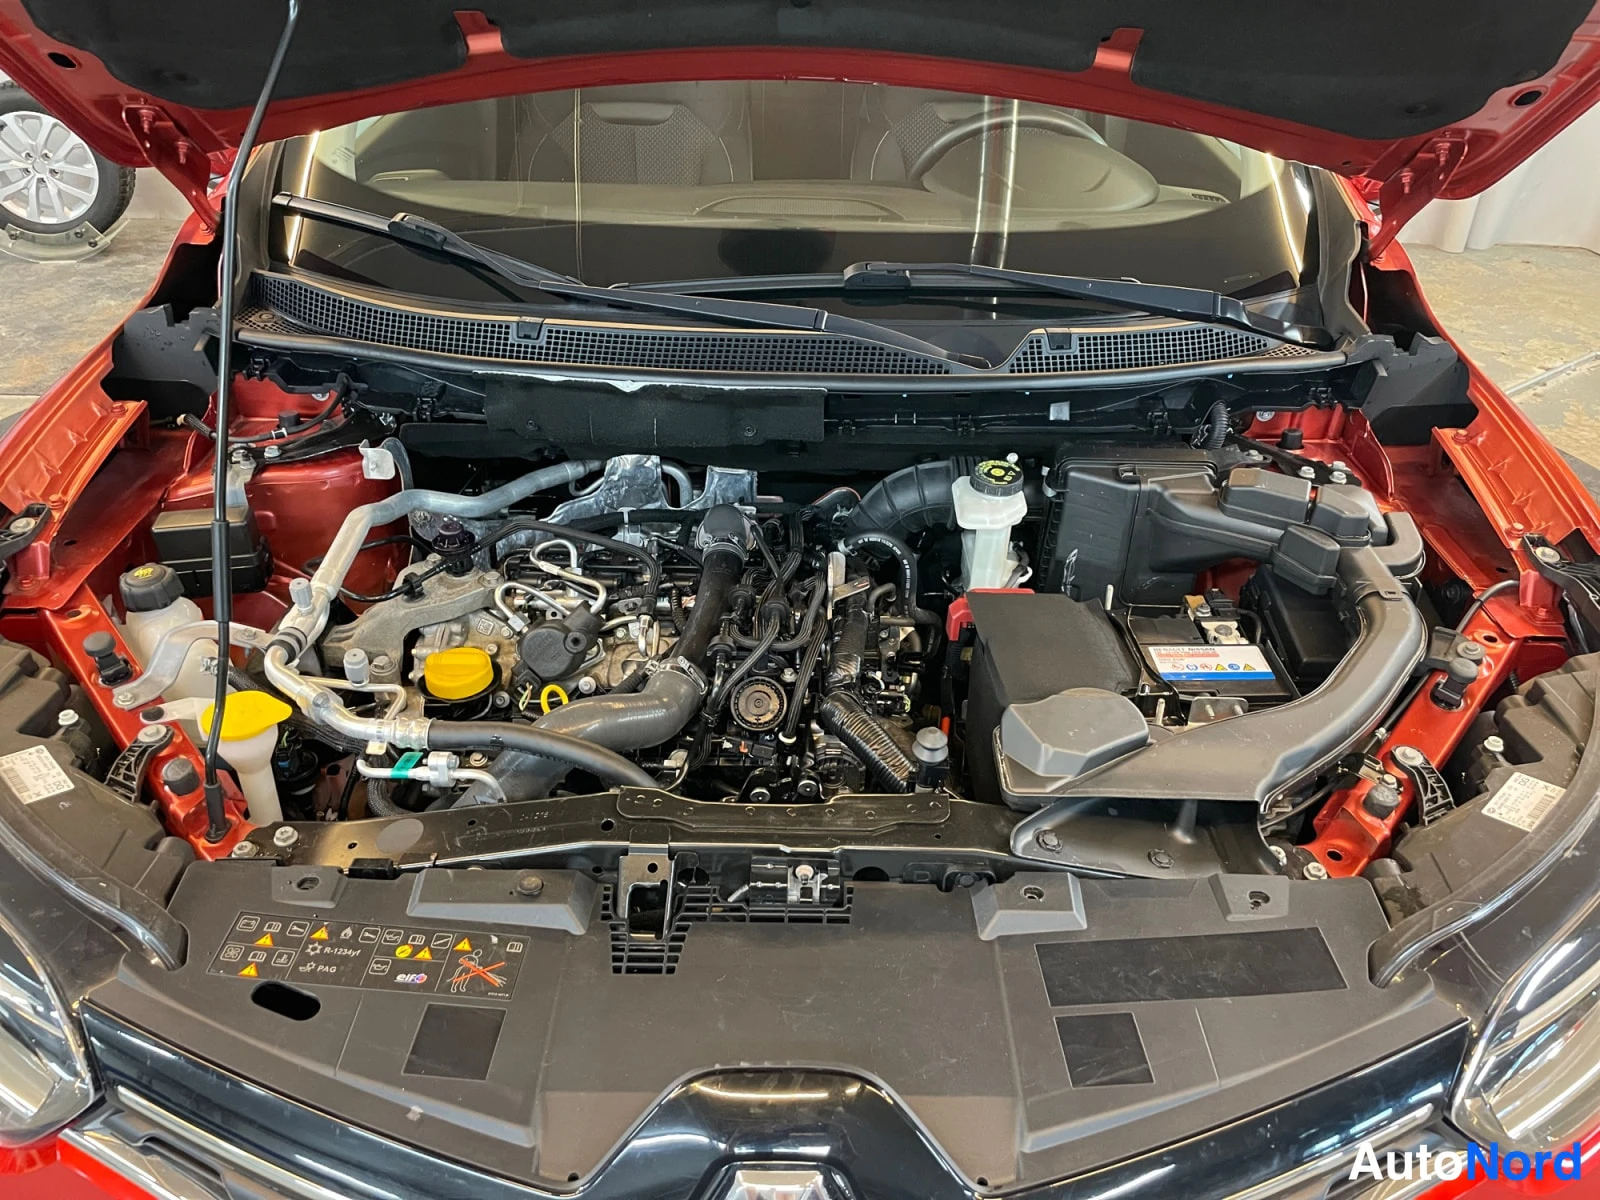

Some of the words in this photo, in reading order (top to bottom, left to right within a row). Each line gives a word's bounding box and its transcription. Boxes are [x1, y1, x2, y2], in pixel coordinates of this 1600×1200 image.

[323, 946, 362, 957] R-1234yf
[316, 965, 337, 973] PAG
[394, 973, 418, 983] elf
